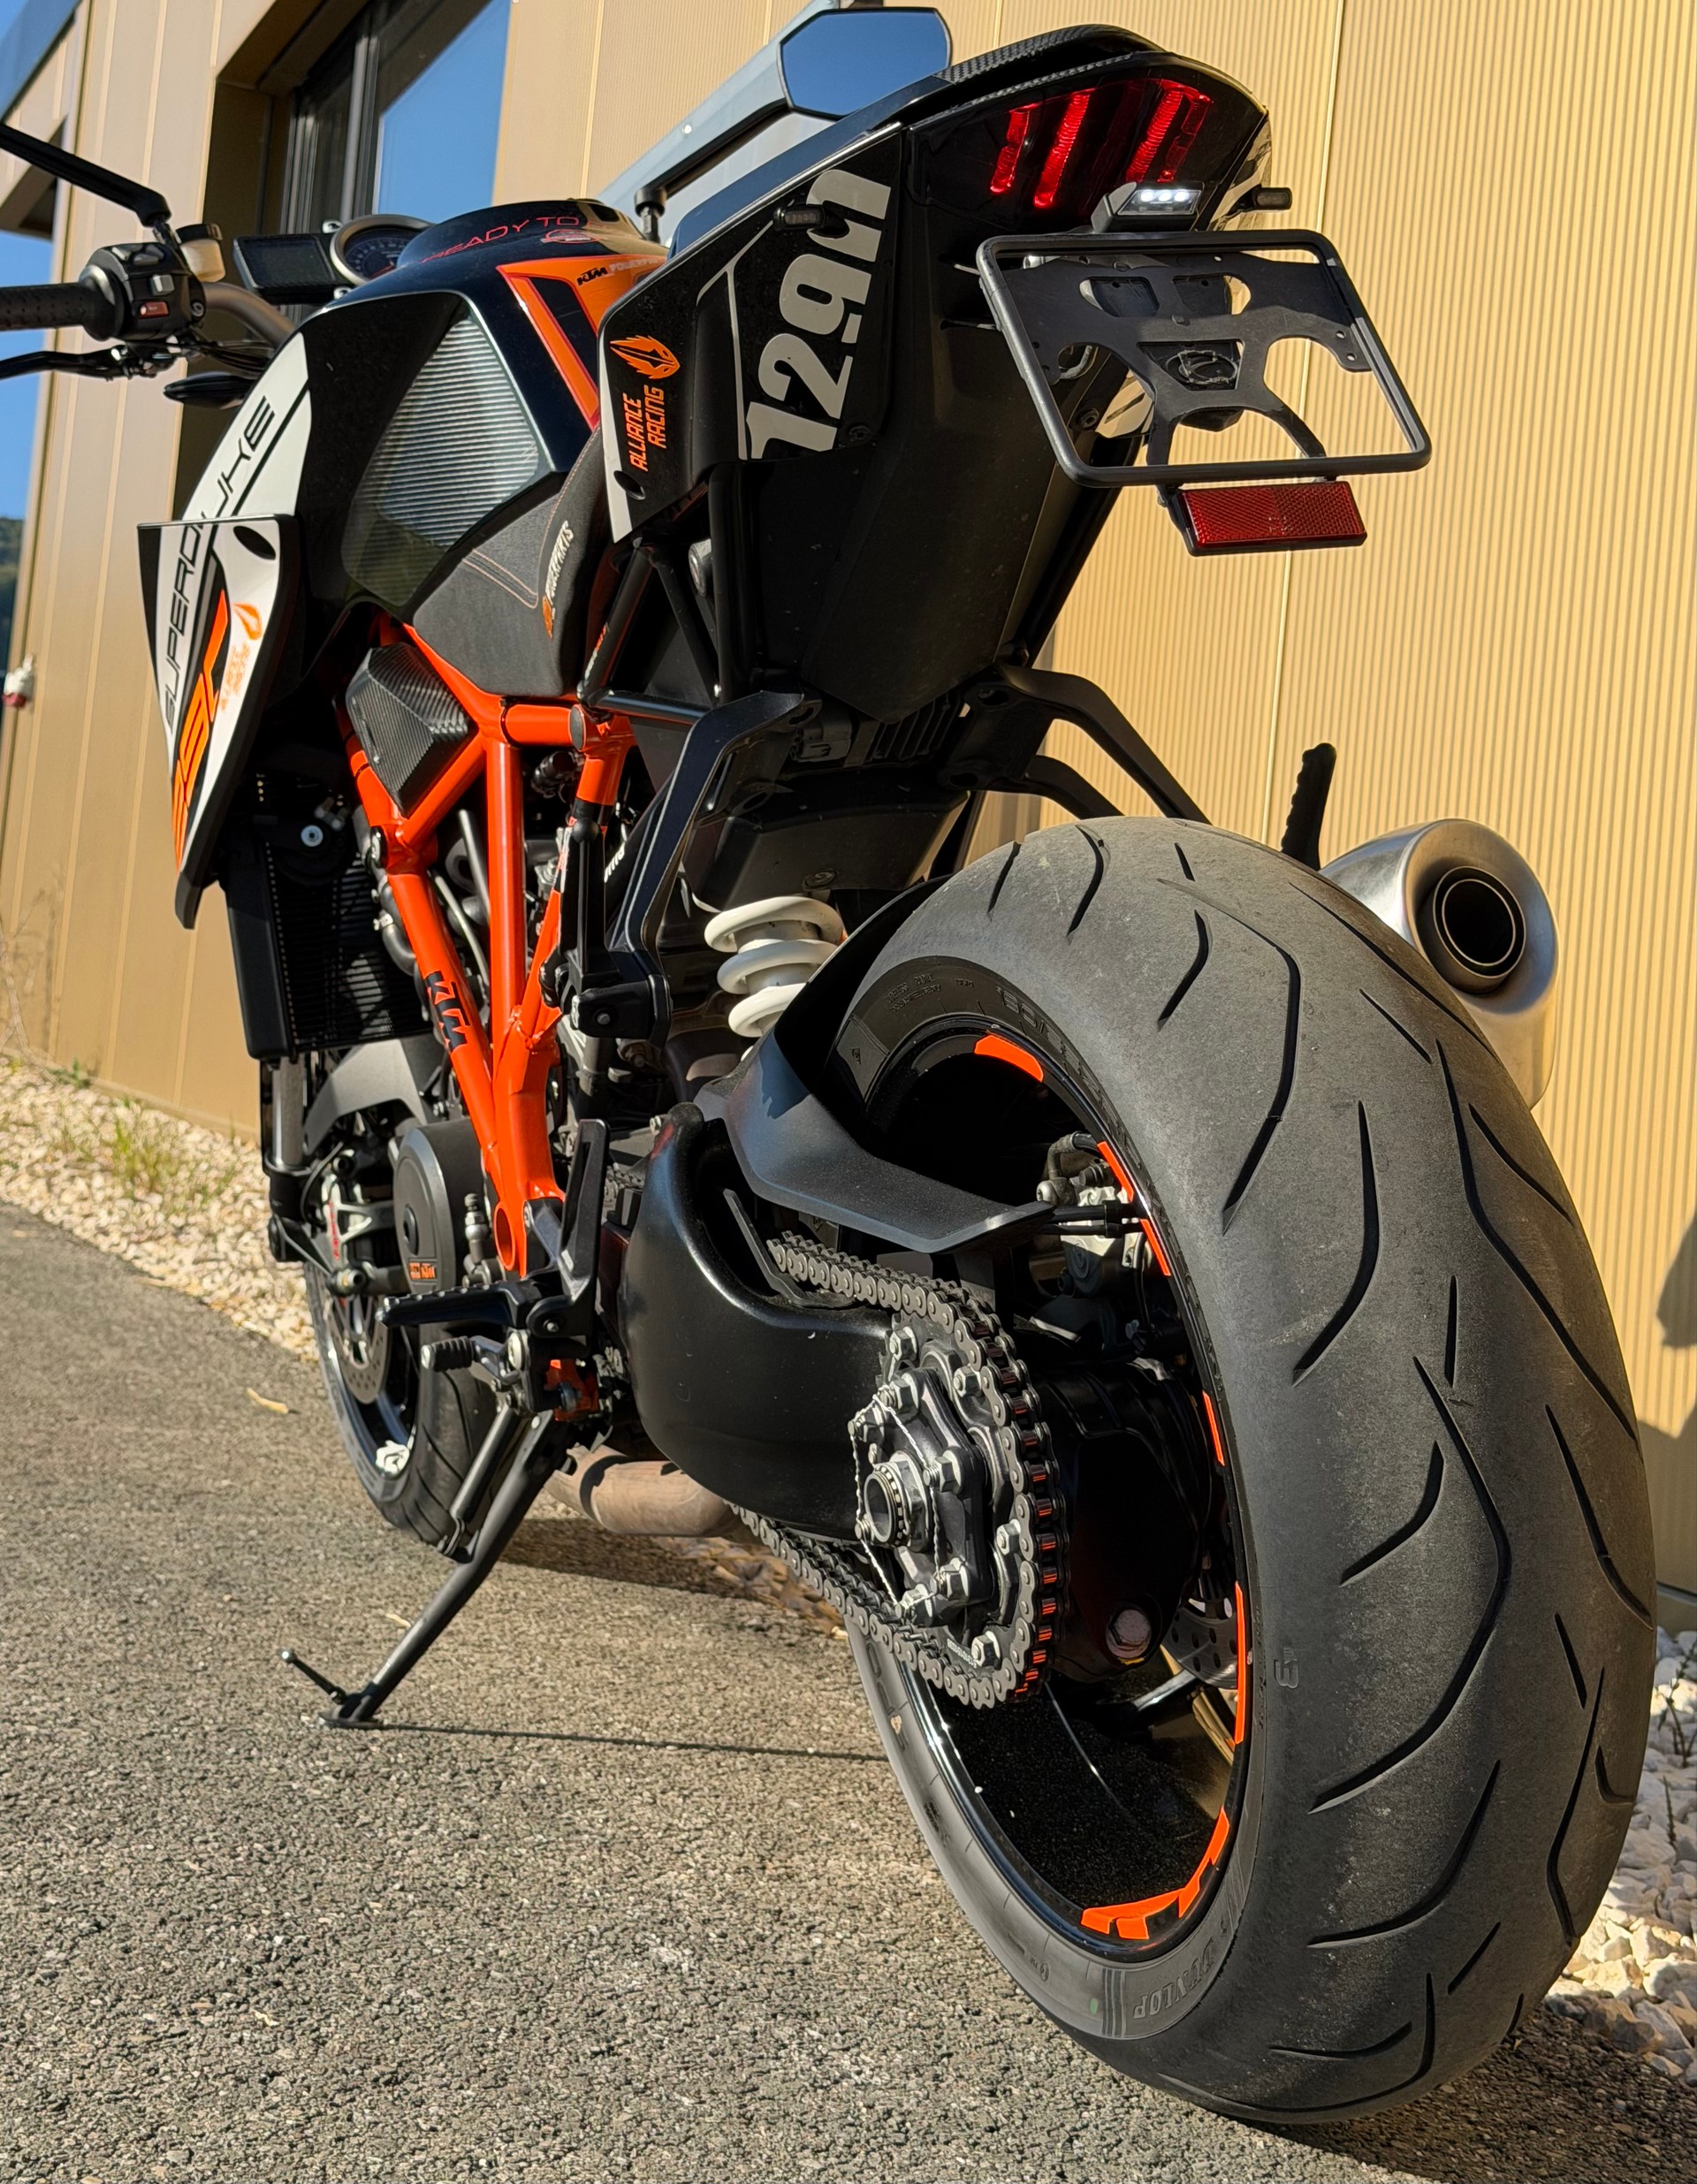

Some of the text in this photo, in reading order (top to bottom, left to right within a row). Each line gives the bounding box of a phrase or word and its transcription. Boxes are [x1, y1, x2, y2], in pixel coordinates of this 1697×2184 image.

[421, 219, 530, 263] READY
[536, 217, 580, 228] TO
[576, 266, 608, 286] KTM
[622, 392, 648, 472] ALLIANCE
[643, 384, 666, 449] RACING
[423, 970, 471, 1052] KTM
[1132, 1937, 1215, 2020] DUNLOP
